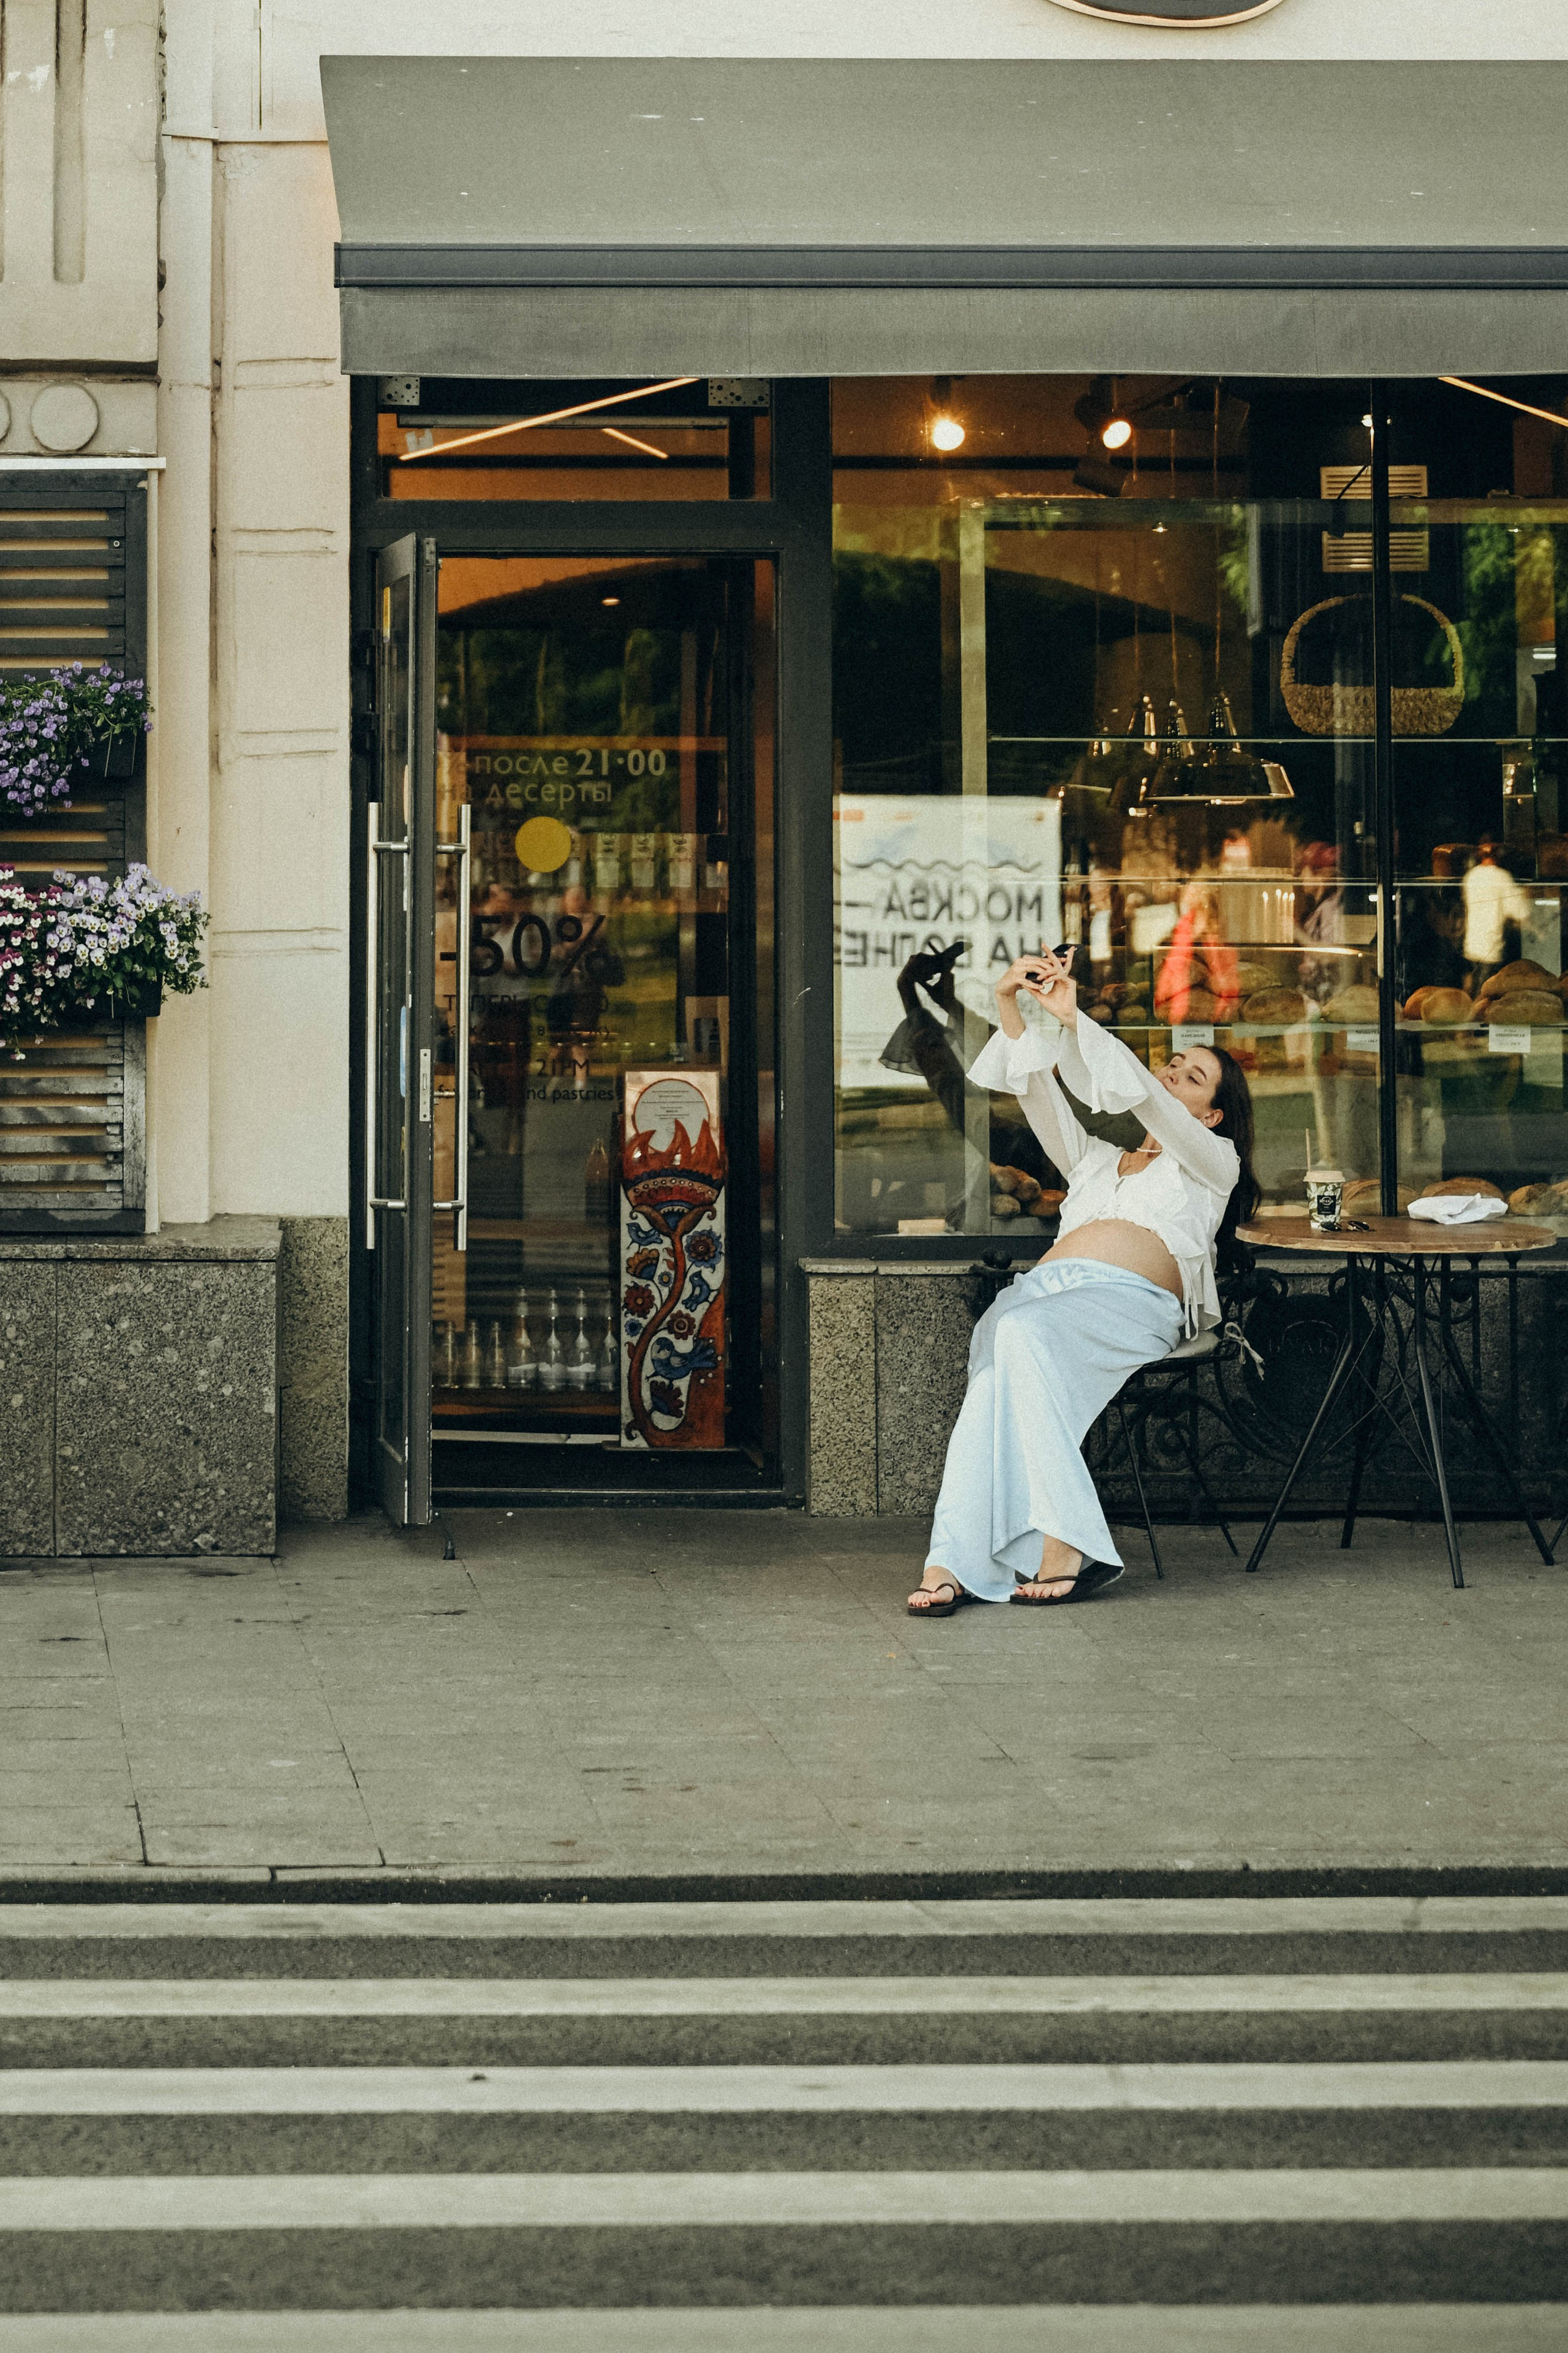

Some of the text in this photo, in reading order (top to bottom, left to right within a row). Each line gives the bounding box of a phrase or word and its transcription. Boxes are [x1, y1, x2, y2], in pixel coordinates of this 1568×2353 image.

[474, 755, 569, 776] после
[484, 781, 612, 810] десерты
[552, 1086, 615, 1104] pastries
